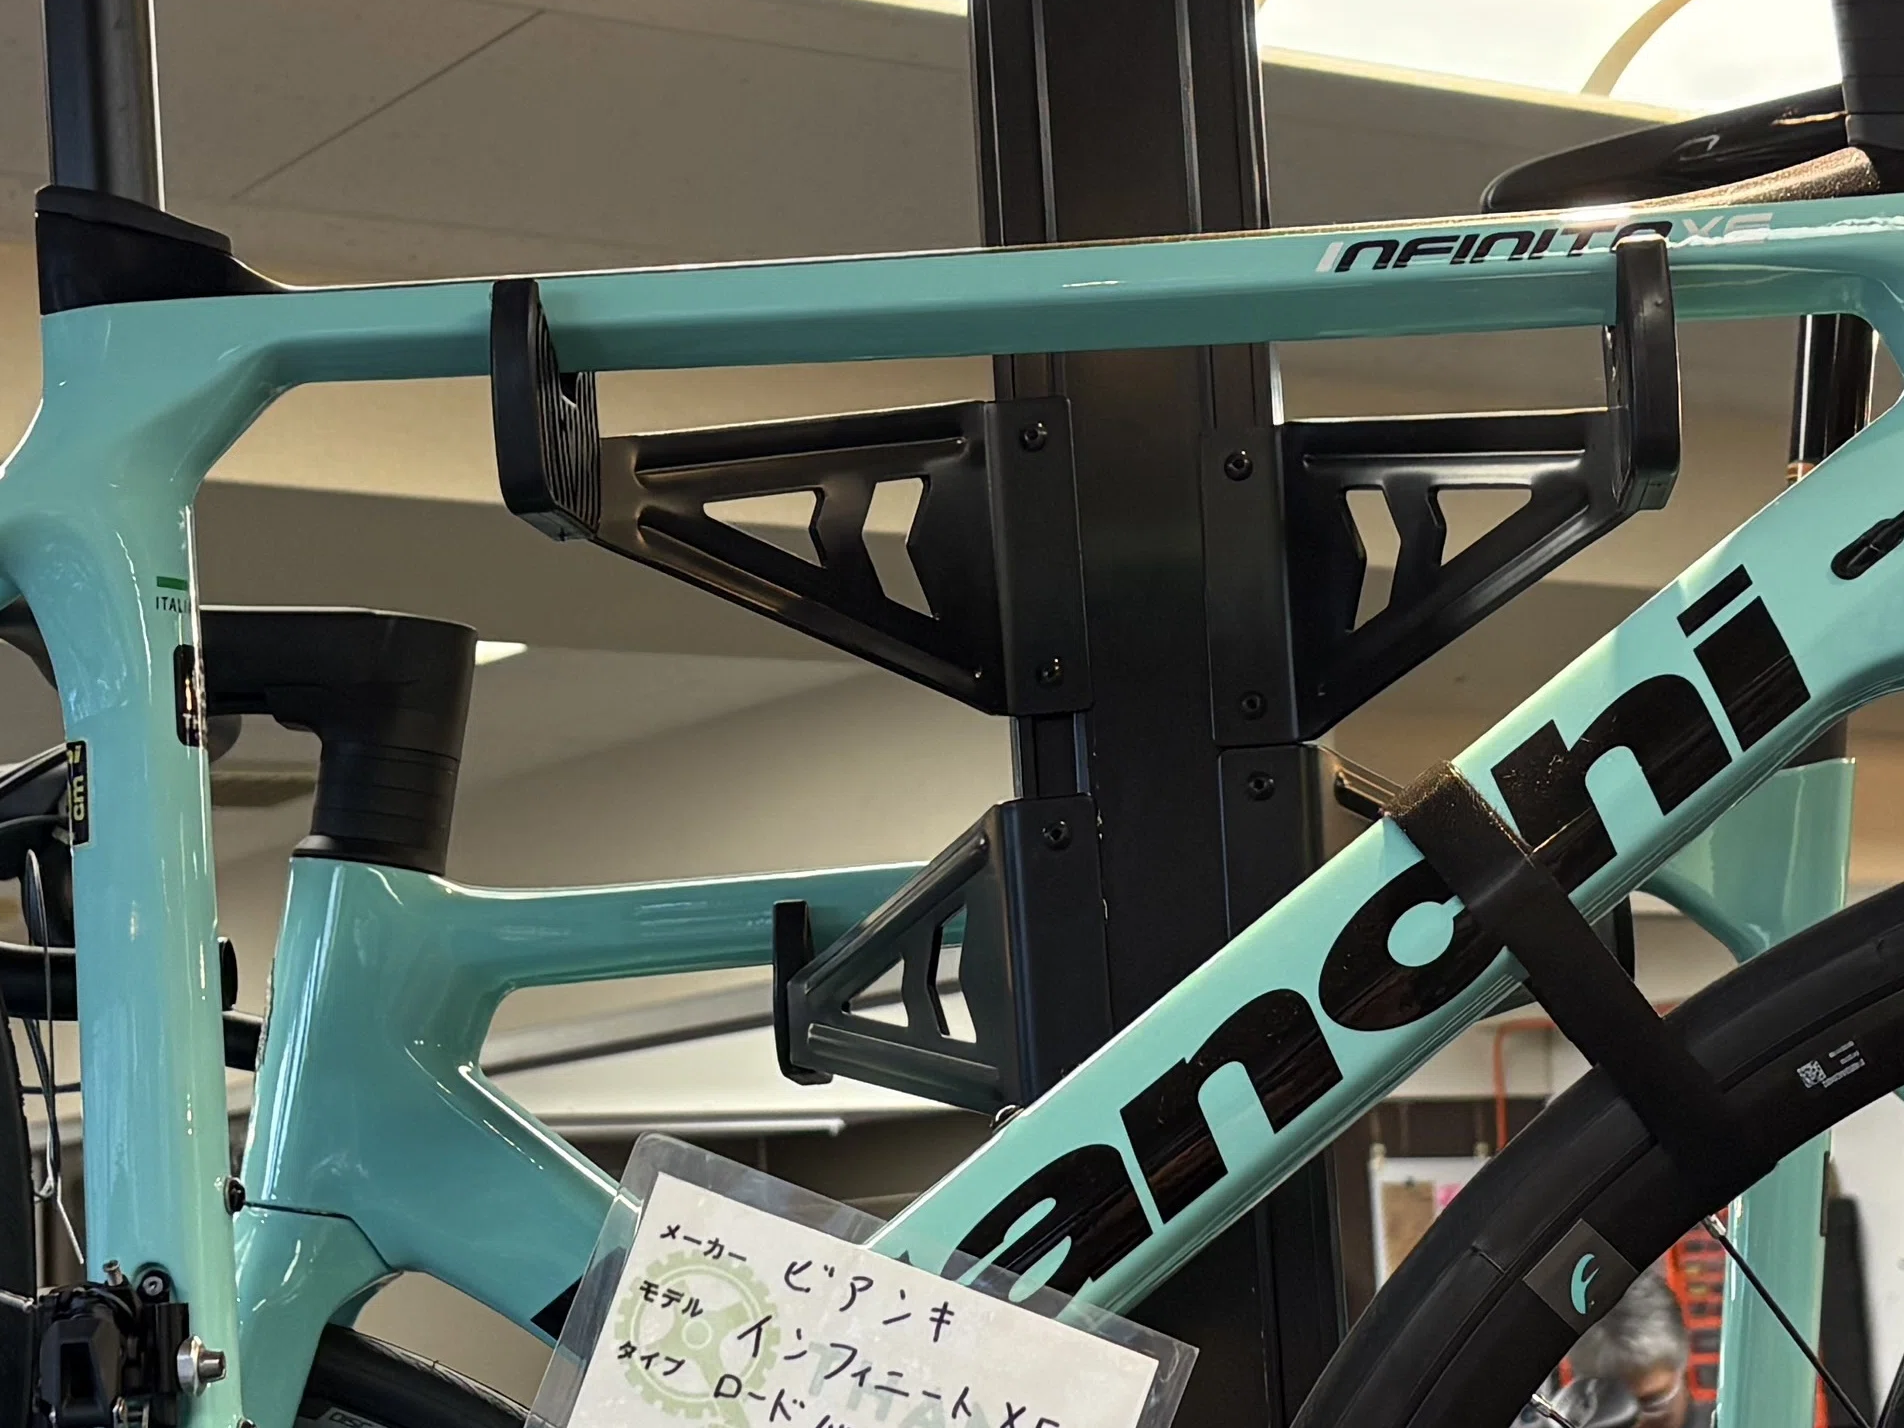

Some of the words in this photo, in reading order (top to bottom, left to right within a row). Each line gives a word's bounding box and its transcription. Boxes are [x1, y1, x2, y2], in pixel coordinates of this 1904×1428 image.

[1680, 212, 1774, 245] XE
[901, 563, 1812, 1334] anchi
[660, 1224, 747, 1261] メーカー
[784, 1259, 955, 1343] ビアンキ
[617, 1340, 686, 1376] タイプ
[639, 1279, 704, 1318] モデル
[737, 1315, 972, 1419] インフィニート
